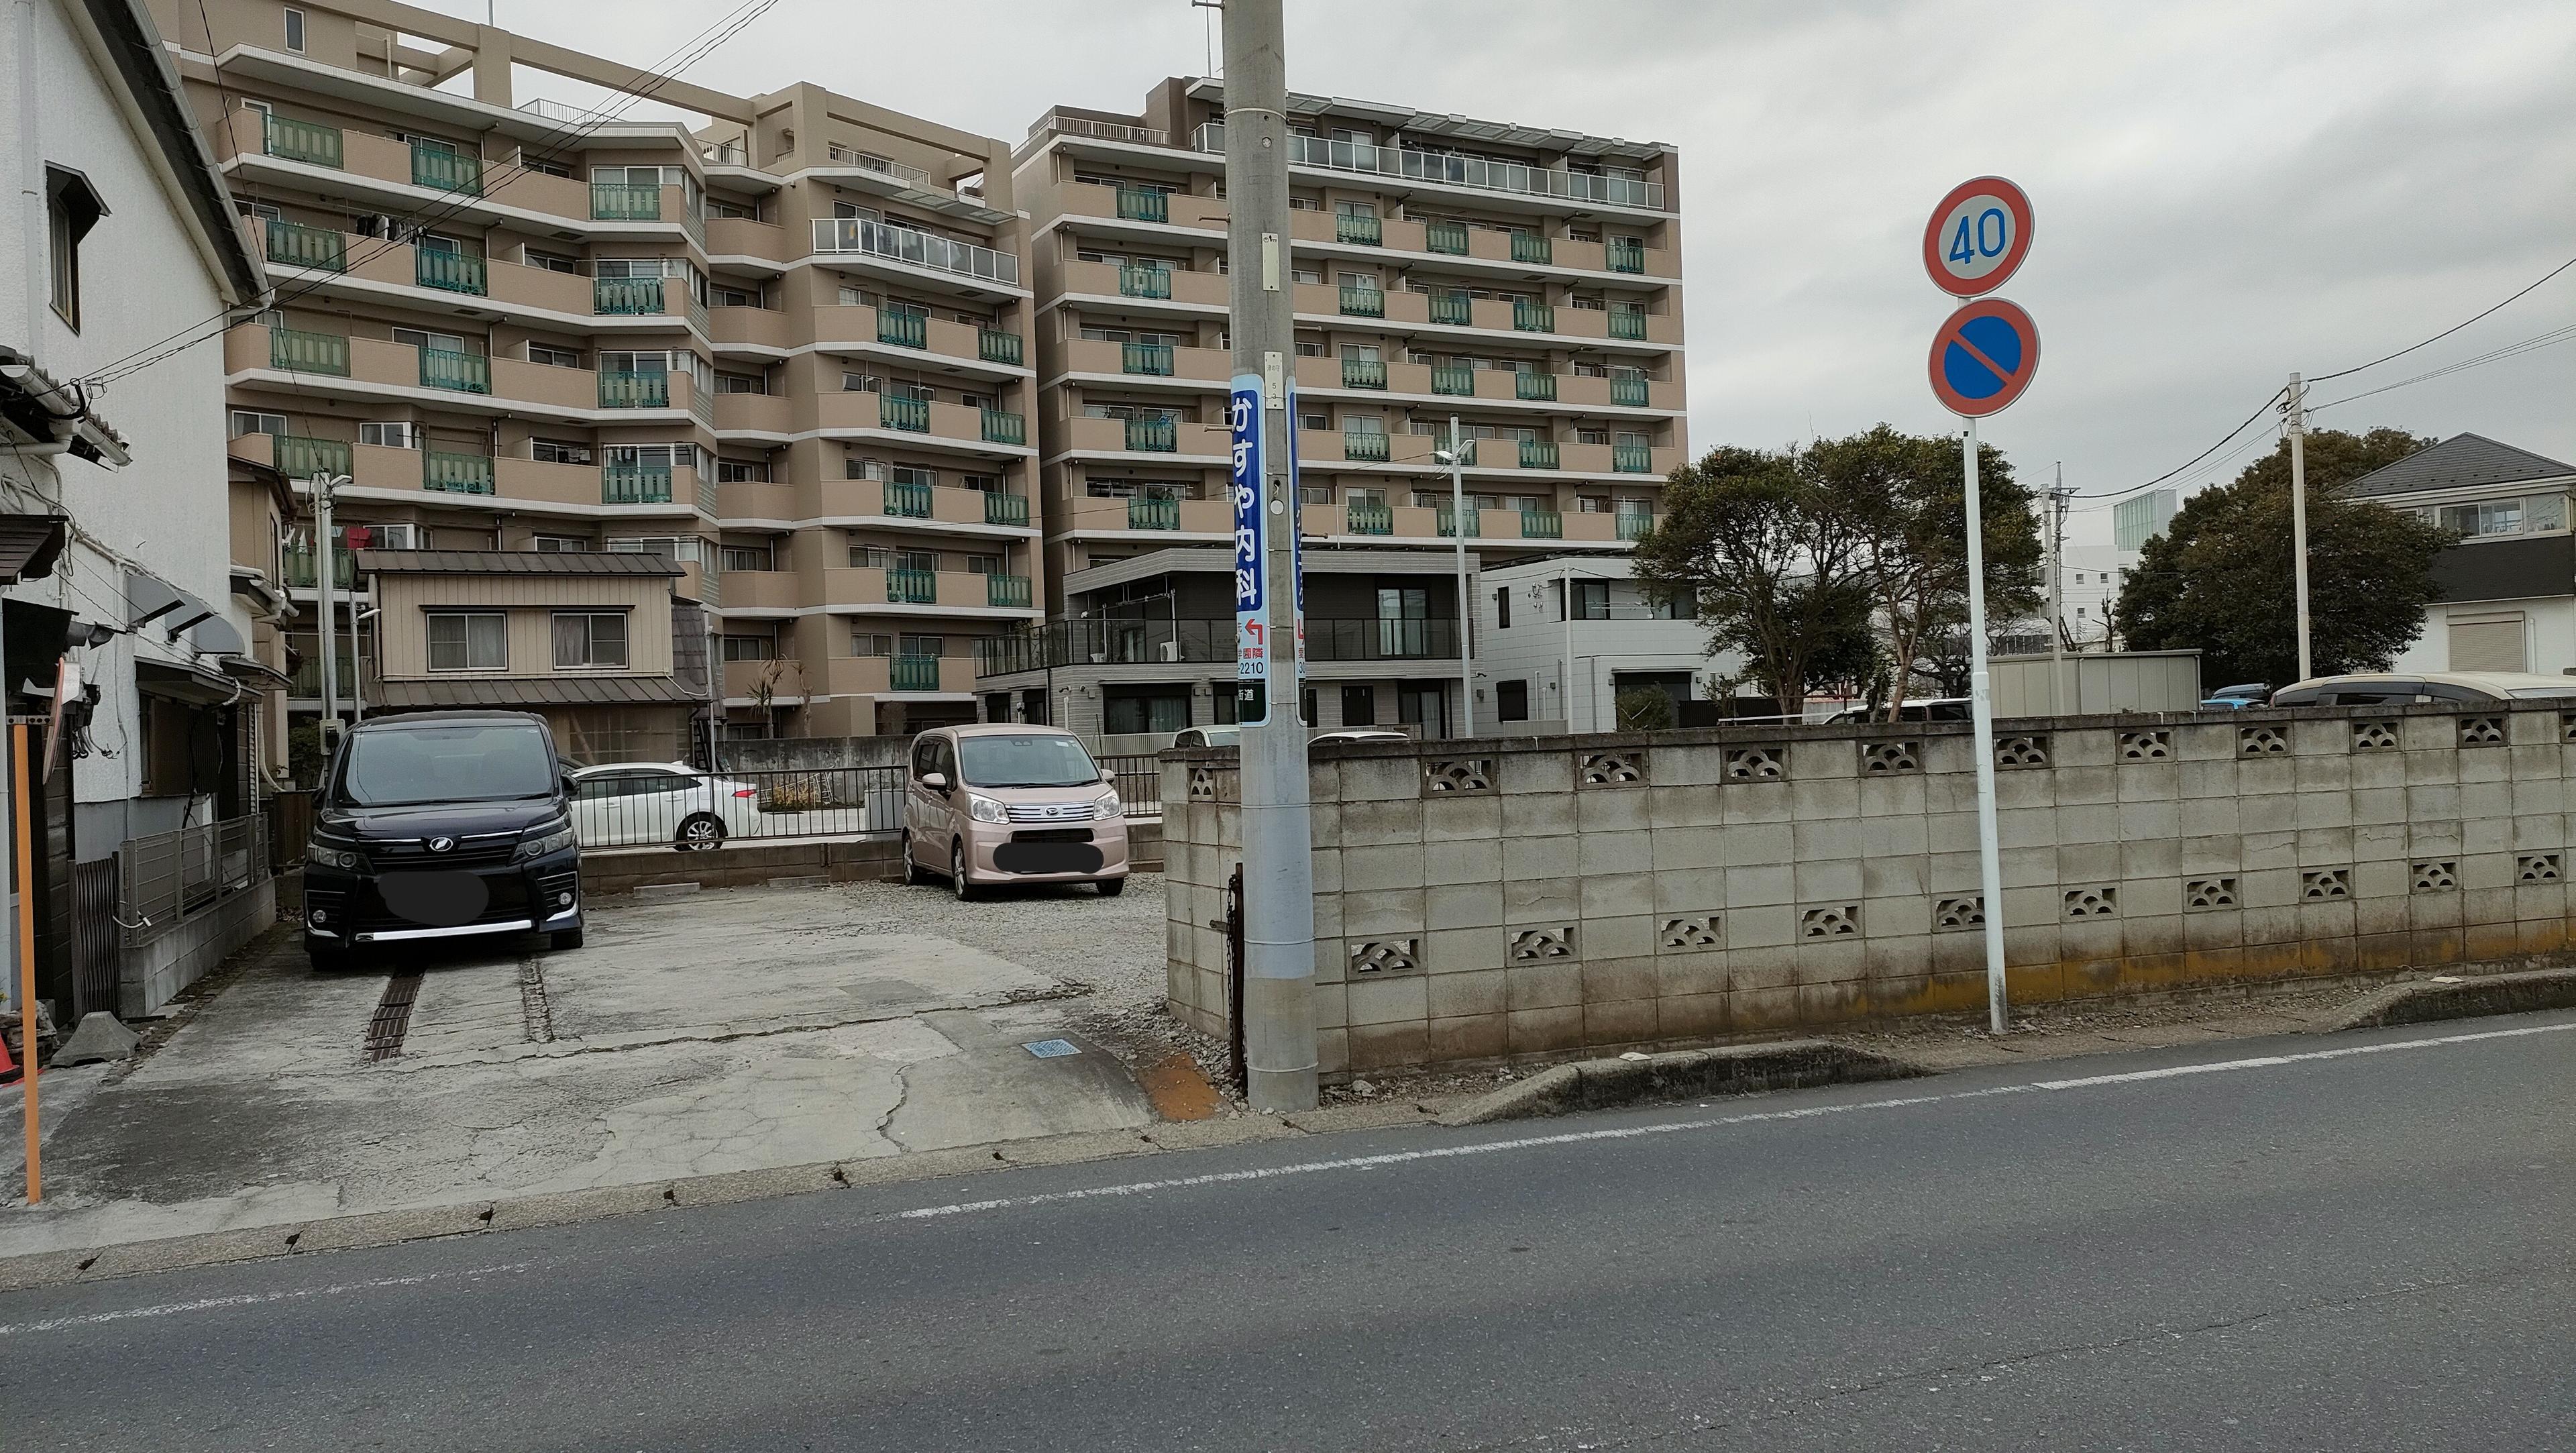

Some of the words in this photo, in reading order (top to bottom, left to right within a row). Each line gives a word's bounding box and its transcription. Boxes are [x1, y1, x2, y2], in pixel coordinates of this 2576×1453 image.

[1949, 207, 2006, 264] 40
[1232, 397, 1257, 606] かすや内科
